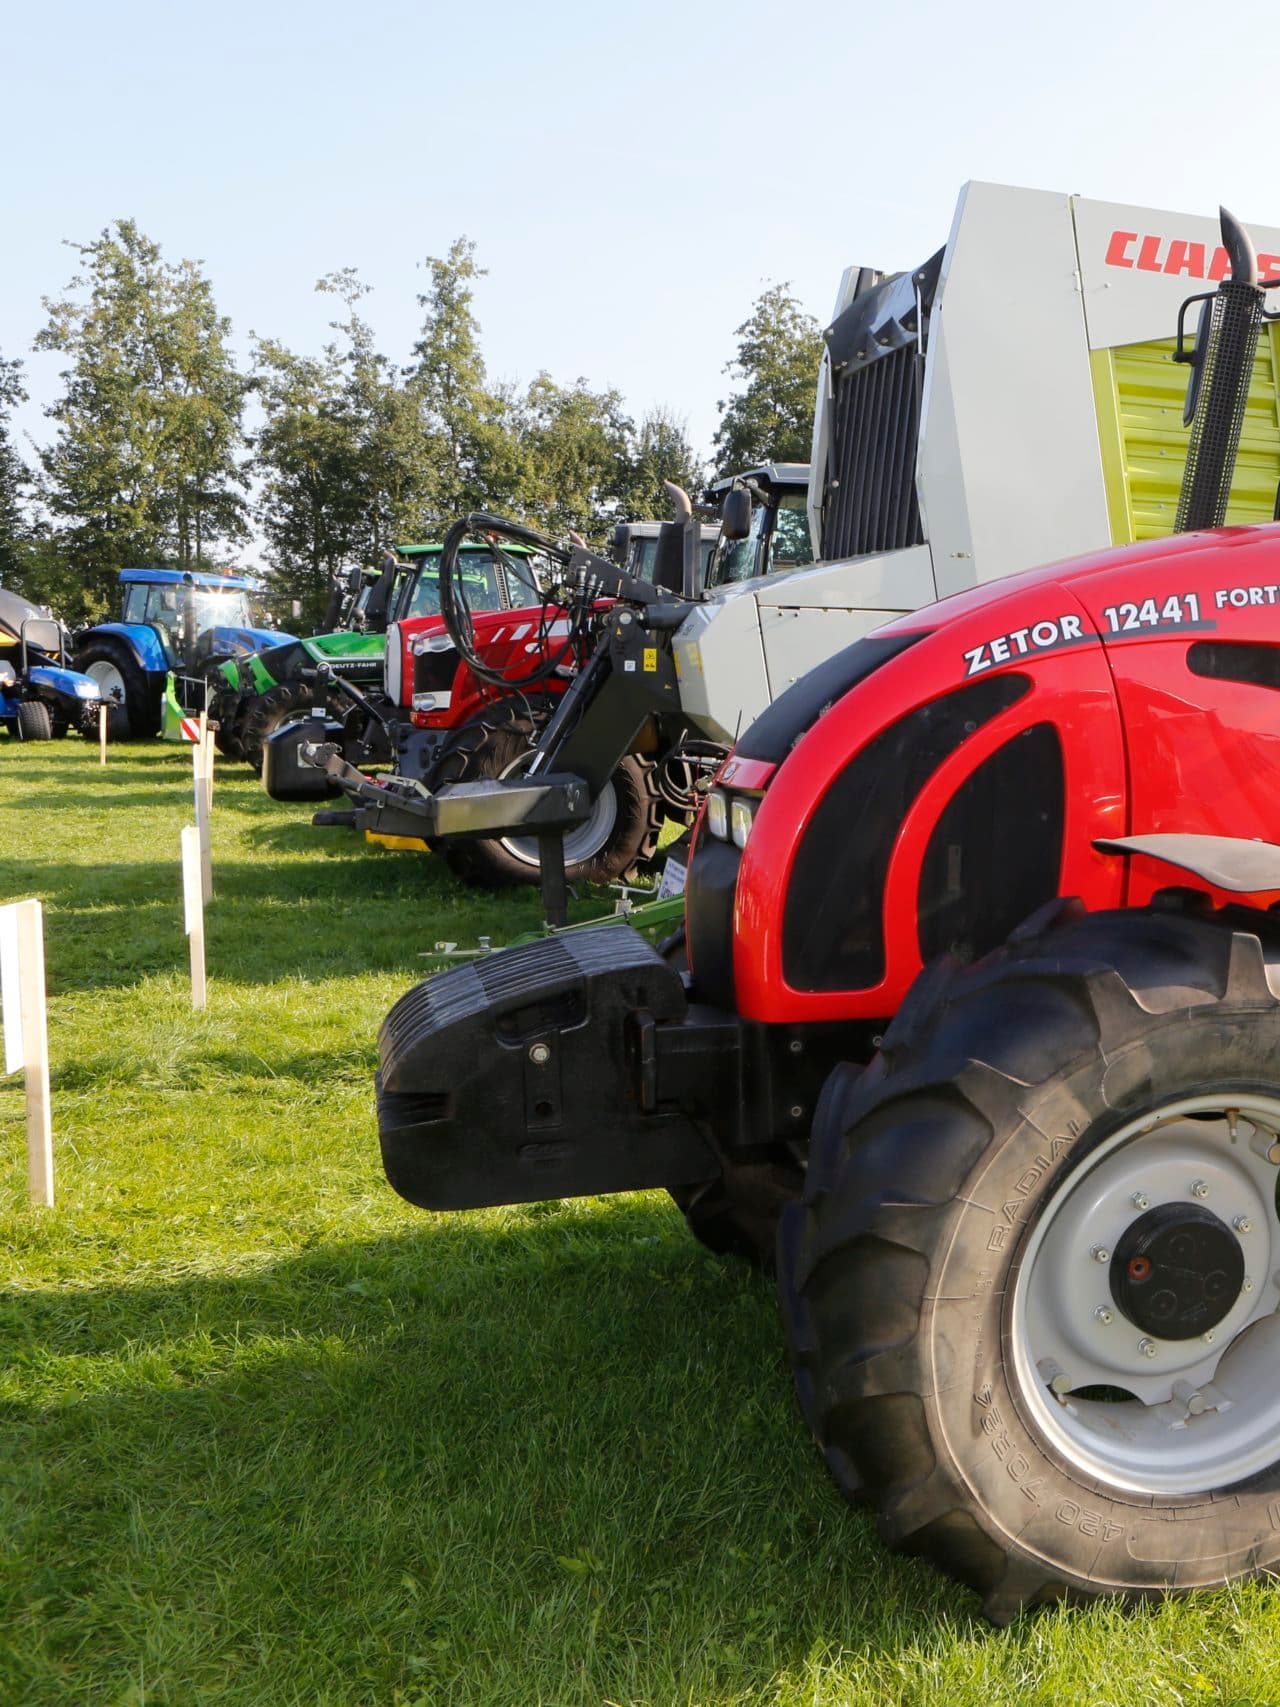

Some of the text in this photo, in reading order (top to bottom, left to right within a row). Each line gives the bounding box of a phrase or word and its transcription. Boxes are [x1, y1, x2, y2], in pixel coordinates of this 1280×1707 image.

[964, 614, 1084, 676] ZETOR
[1104, 593, 1200, 632] 12441
[987, 1119, 1086, 1252] RADIAL
[1055, 1498, 1124, 1542] 420
